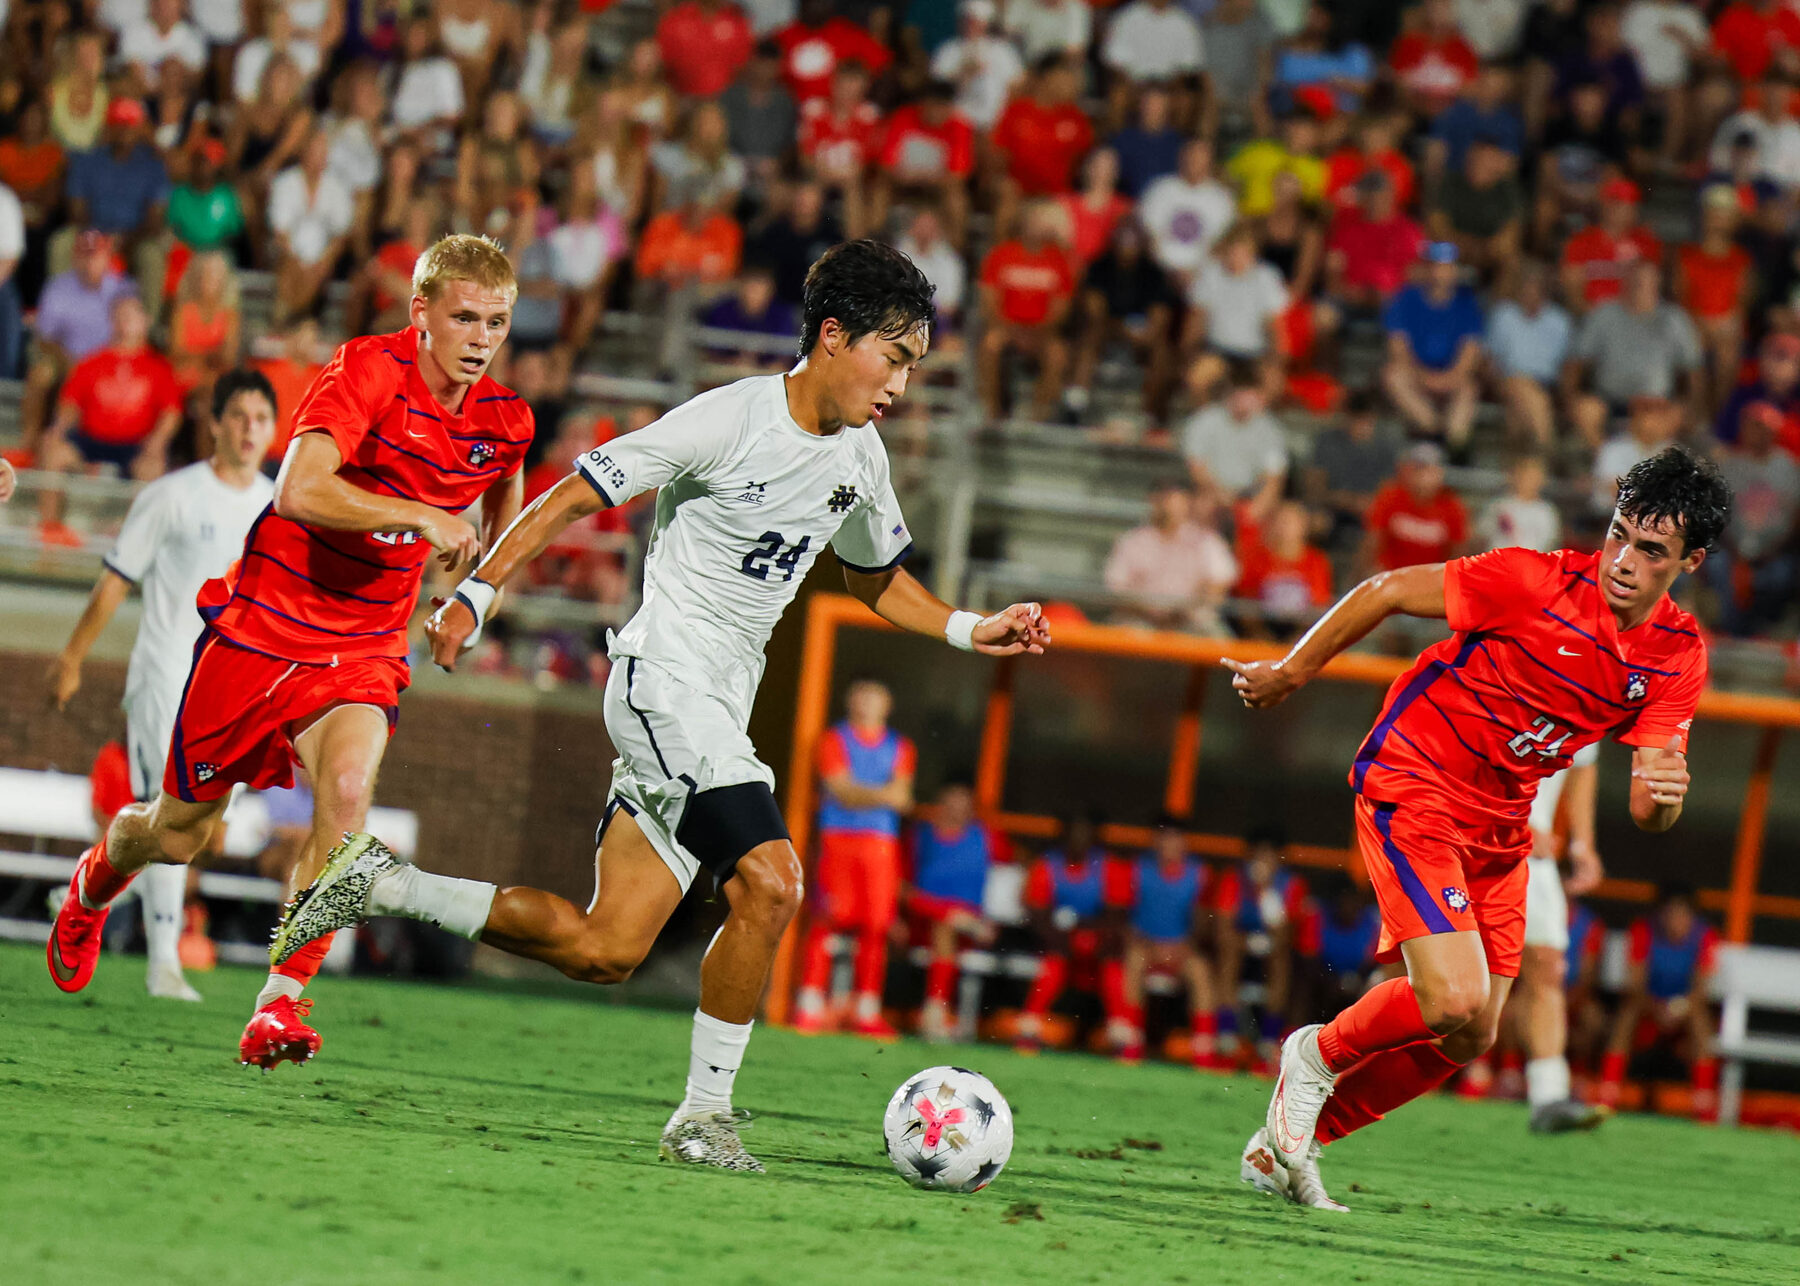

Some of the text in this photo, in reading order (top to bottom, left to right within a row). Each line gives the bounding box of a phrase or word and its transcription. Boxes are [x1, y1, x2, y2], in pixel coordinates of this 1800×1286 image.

[738, 491, 766, 504] ACC
[742, 530, 811, 581] 24
[1507, 715, 1574, 762] 24
